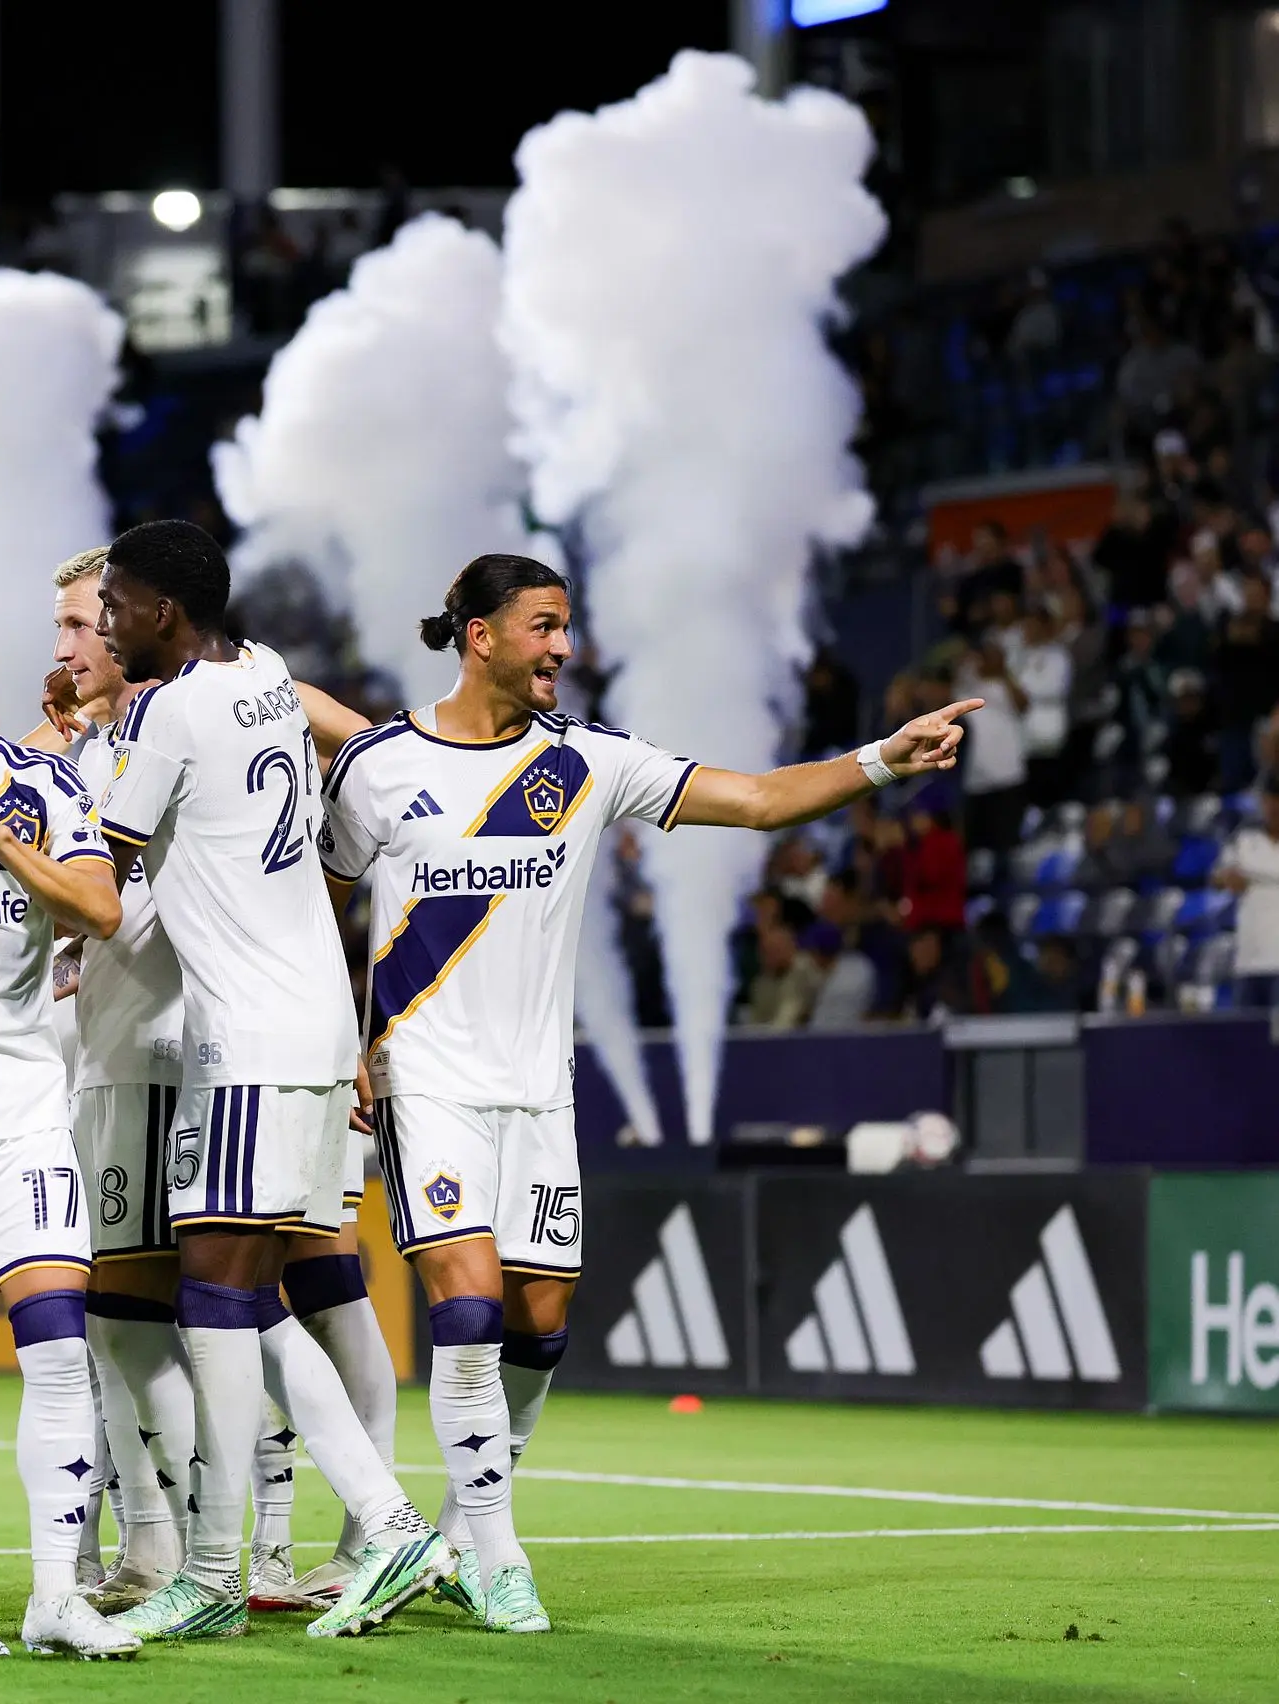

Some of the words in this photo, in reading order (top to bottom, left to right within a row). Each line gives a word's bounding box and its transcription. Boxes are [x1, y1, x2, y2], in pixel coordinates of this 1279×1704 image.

[533, 797, 557, 811] LA
[19, 827, 33, 842] A
[412, 857, 554, 893] Herbalife
[198, 1042, 223, 1067] 96
[22, 1167, 79, 1231] 17
[433, 1188, 458, 1204] LA
[530, 1183, 580, 1248] 15
